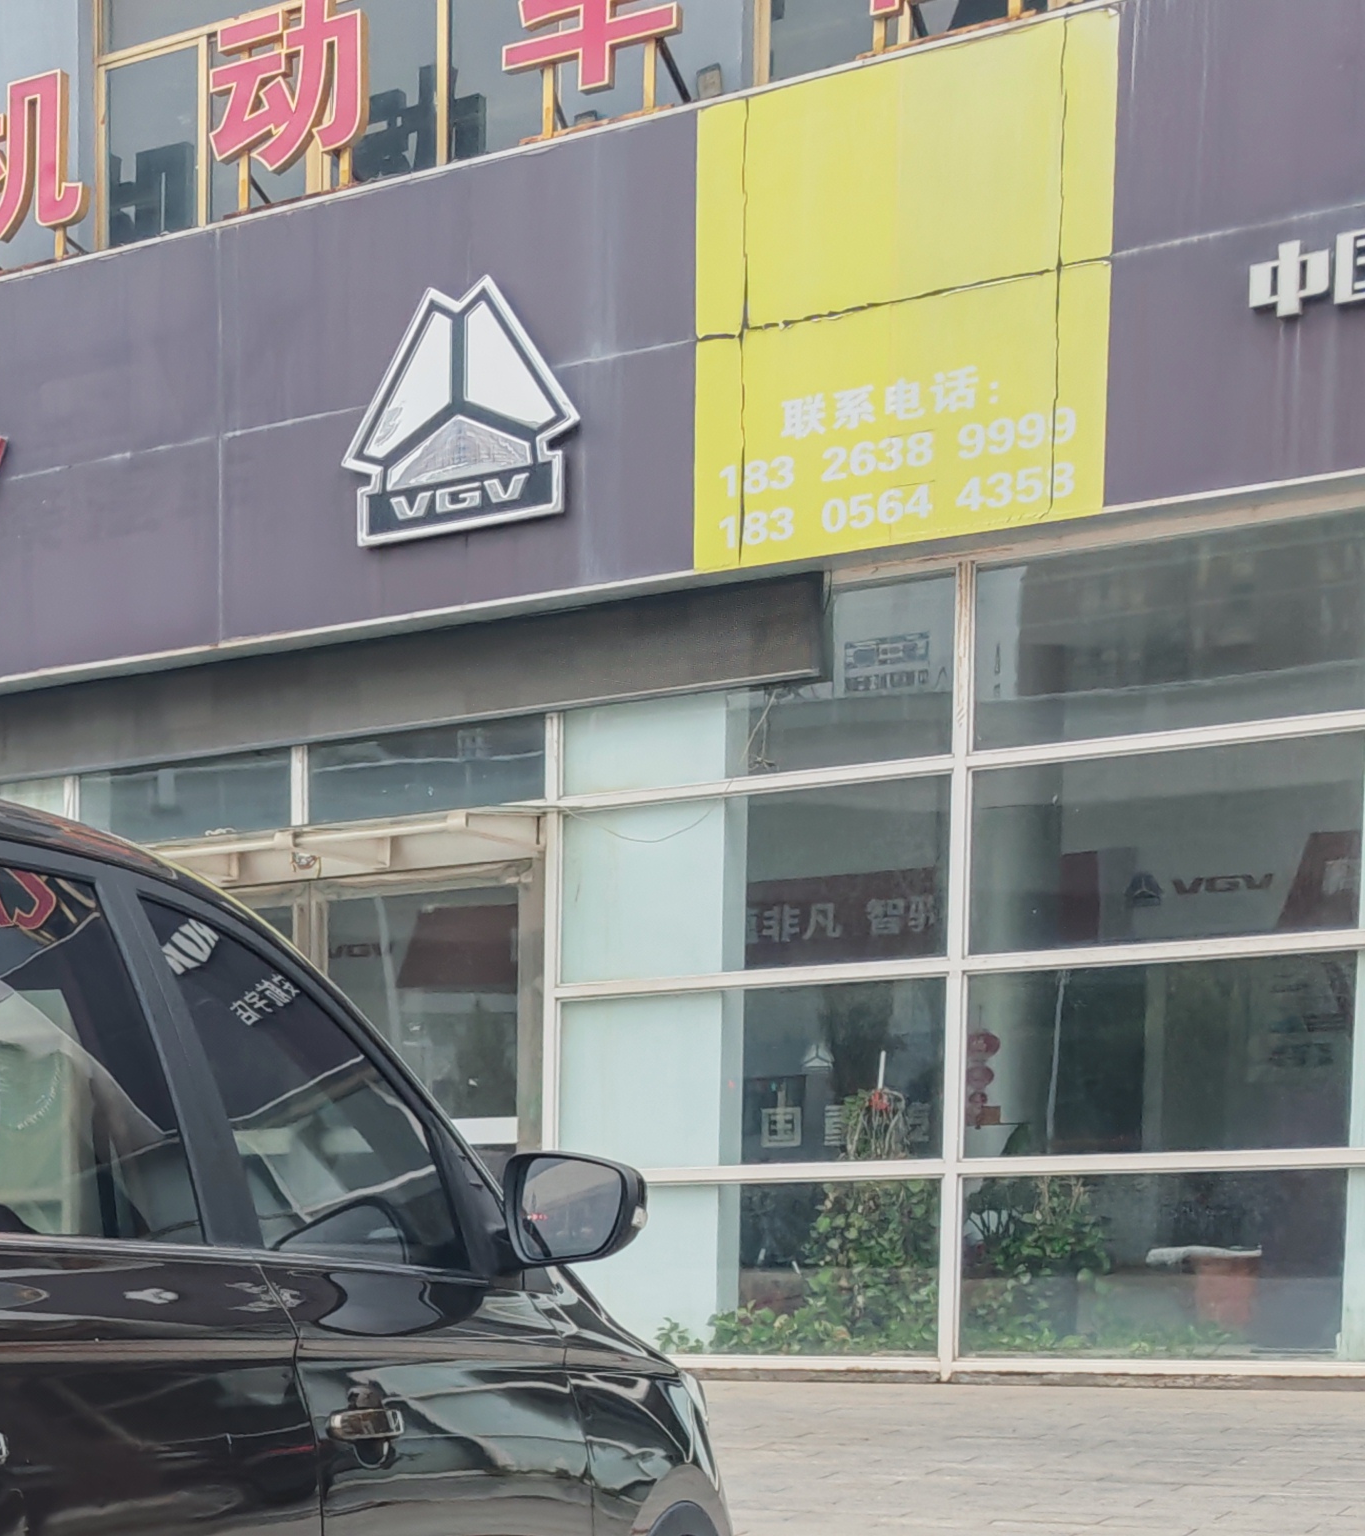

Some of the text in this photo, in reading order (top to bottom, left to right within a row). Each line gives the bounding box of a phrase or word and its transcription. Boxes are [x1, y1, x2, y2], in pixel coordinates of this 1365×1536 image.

[719, 407, 1077, 498] 183 2638 9999
[389, 472, 530, 521] VGV
[719, 461, 1076, 549] 183 0564 4358
[1172, 873, 1275, 895] VGV
